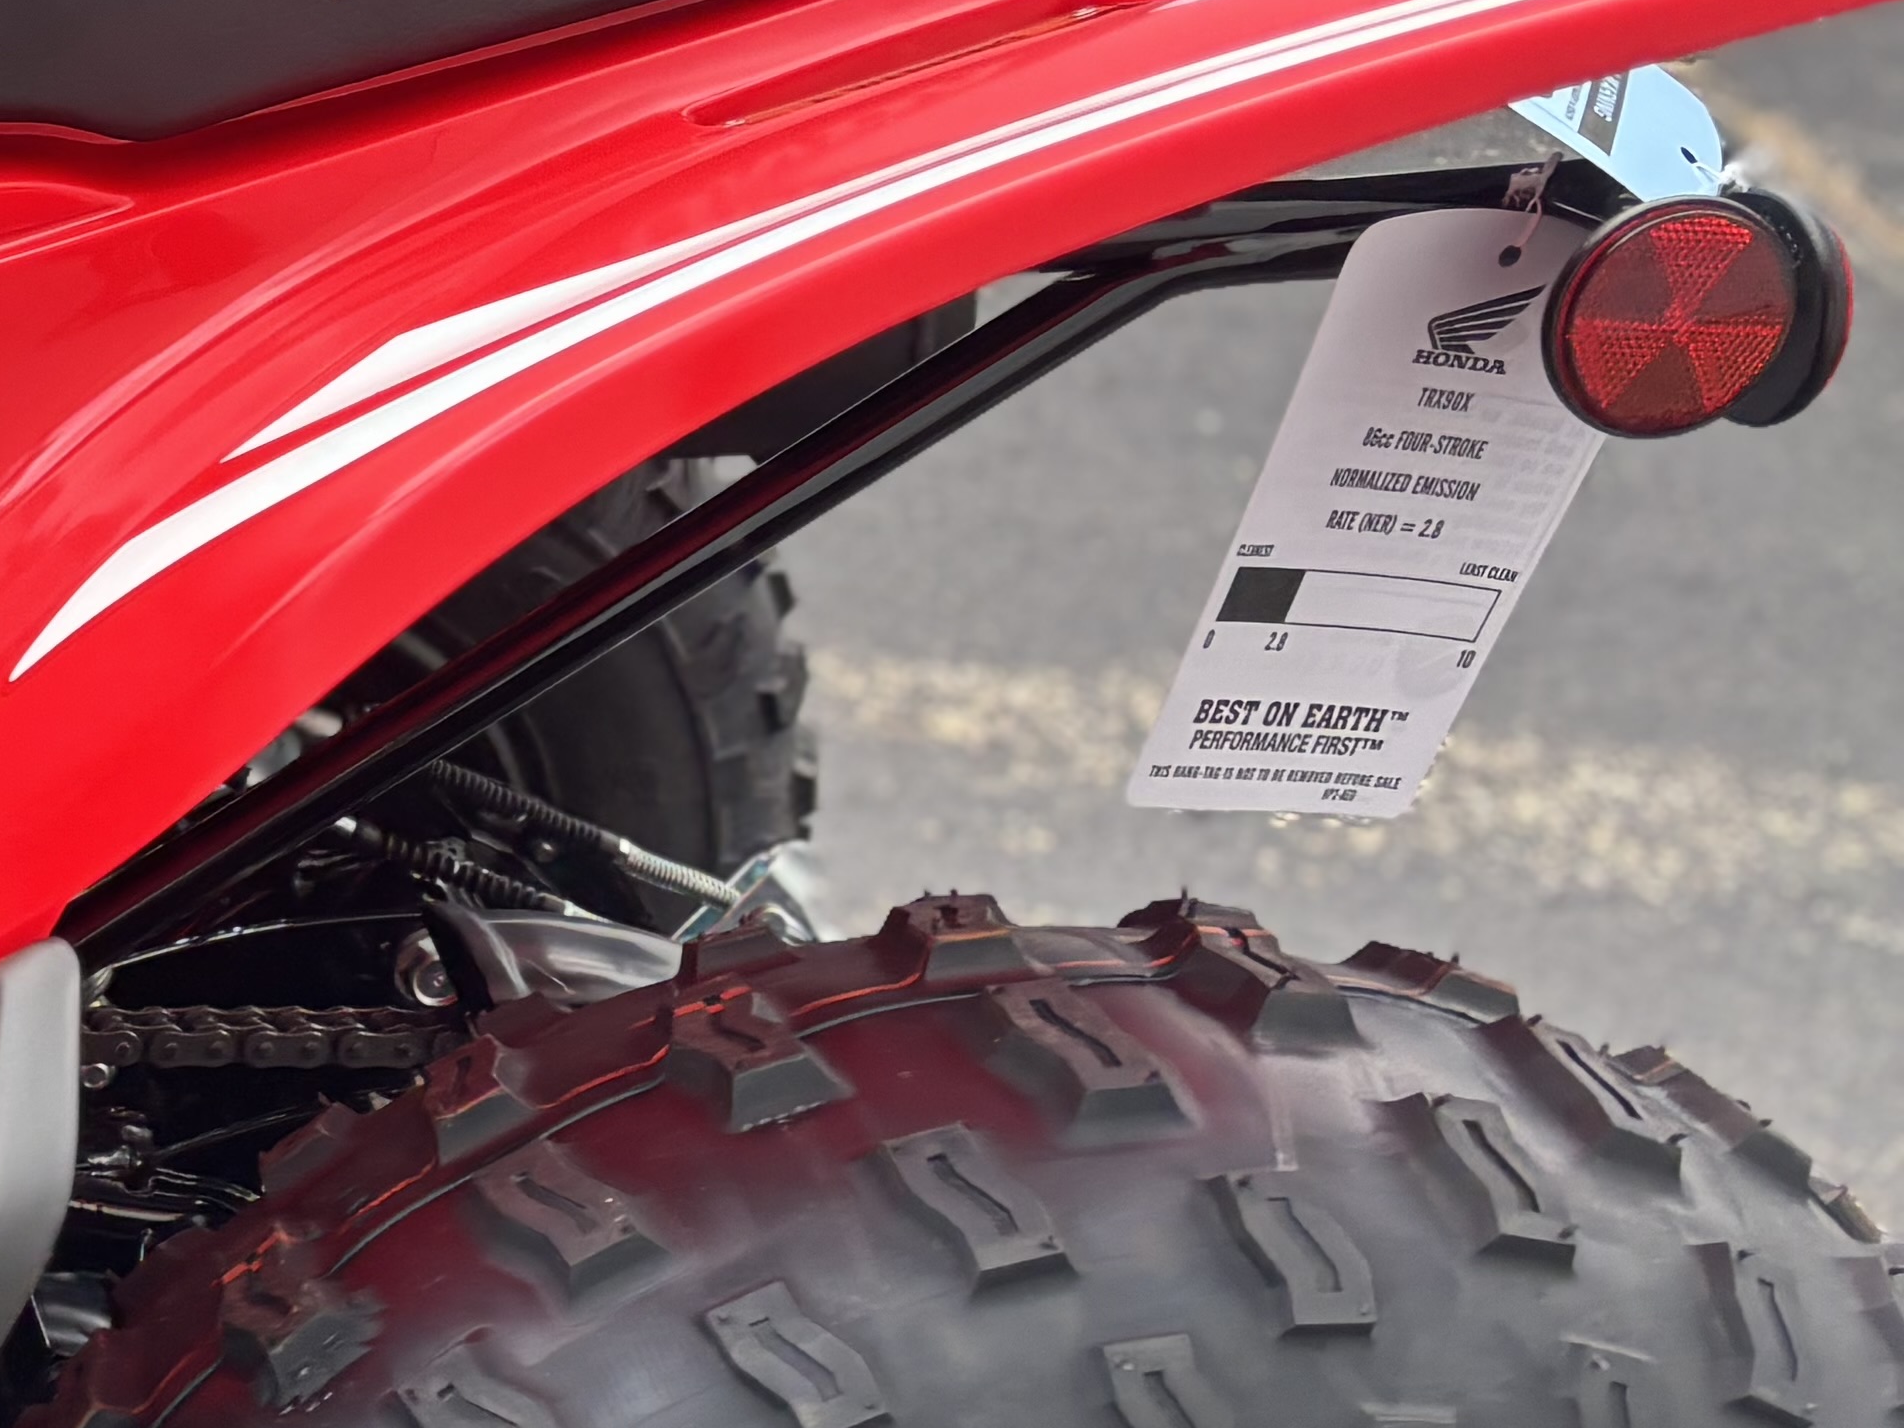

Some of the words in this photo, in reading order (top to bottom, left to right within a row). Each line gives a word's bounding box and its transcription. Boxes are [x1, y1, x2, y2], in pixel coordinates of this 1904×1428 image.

[1412, 349, 1506, 374] HONDA
[1417, 387, 1475, 412] TRX90X
[1363, 427, 1394, 448] 86cc
[1395, 430, 1489, 460] FOUR-STROKE
[1330, 468, 1412, 493] NORMALIZED
[1412, 475, 1480, 501] EMISSION
[1326, 510, 1360, 529] RATE
[1358, 512, 1397, 534] (NER)
[1203, 629, 1215, 649] 0
[1264, 632, 1288, 652] 2.8
[1456, 649, 1476, 669] 10
[1192, 699, 1261, 725] BEST
[1262, 701, 1300, 727] ON
[1189, 729, 1310, 754] PERFORMANCE
